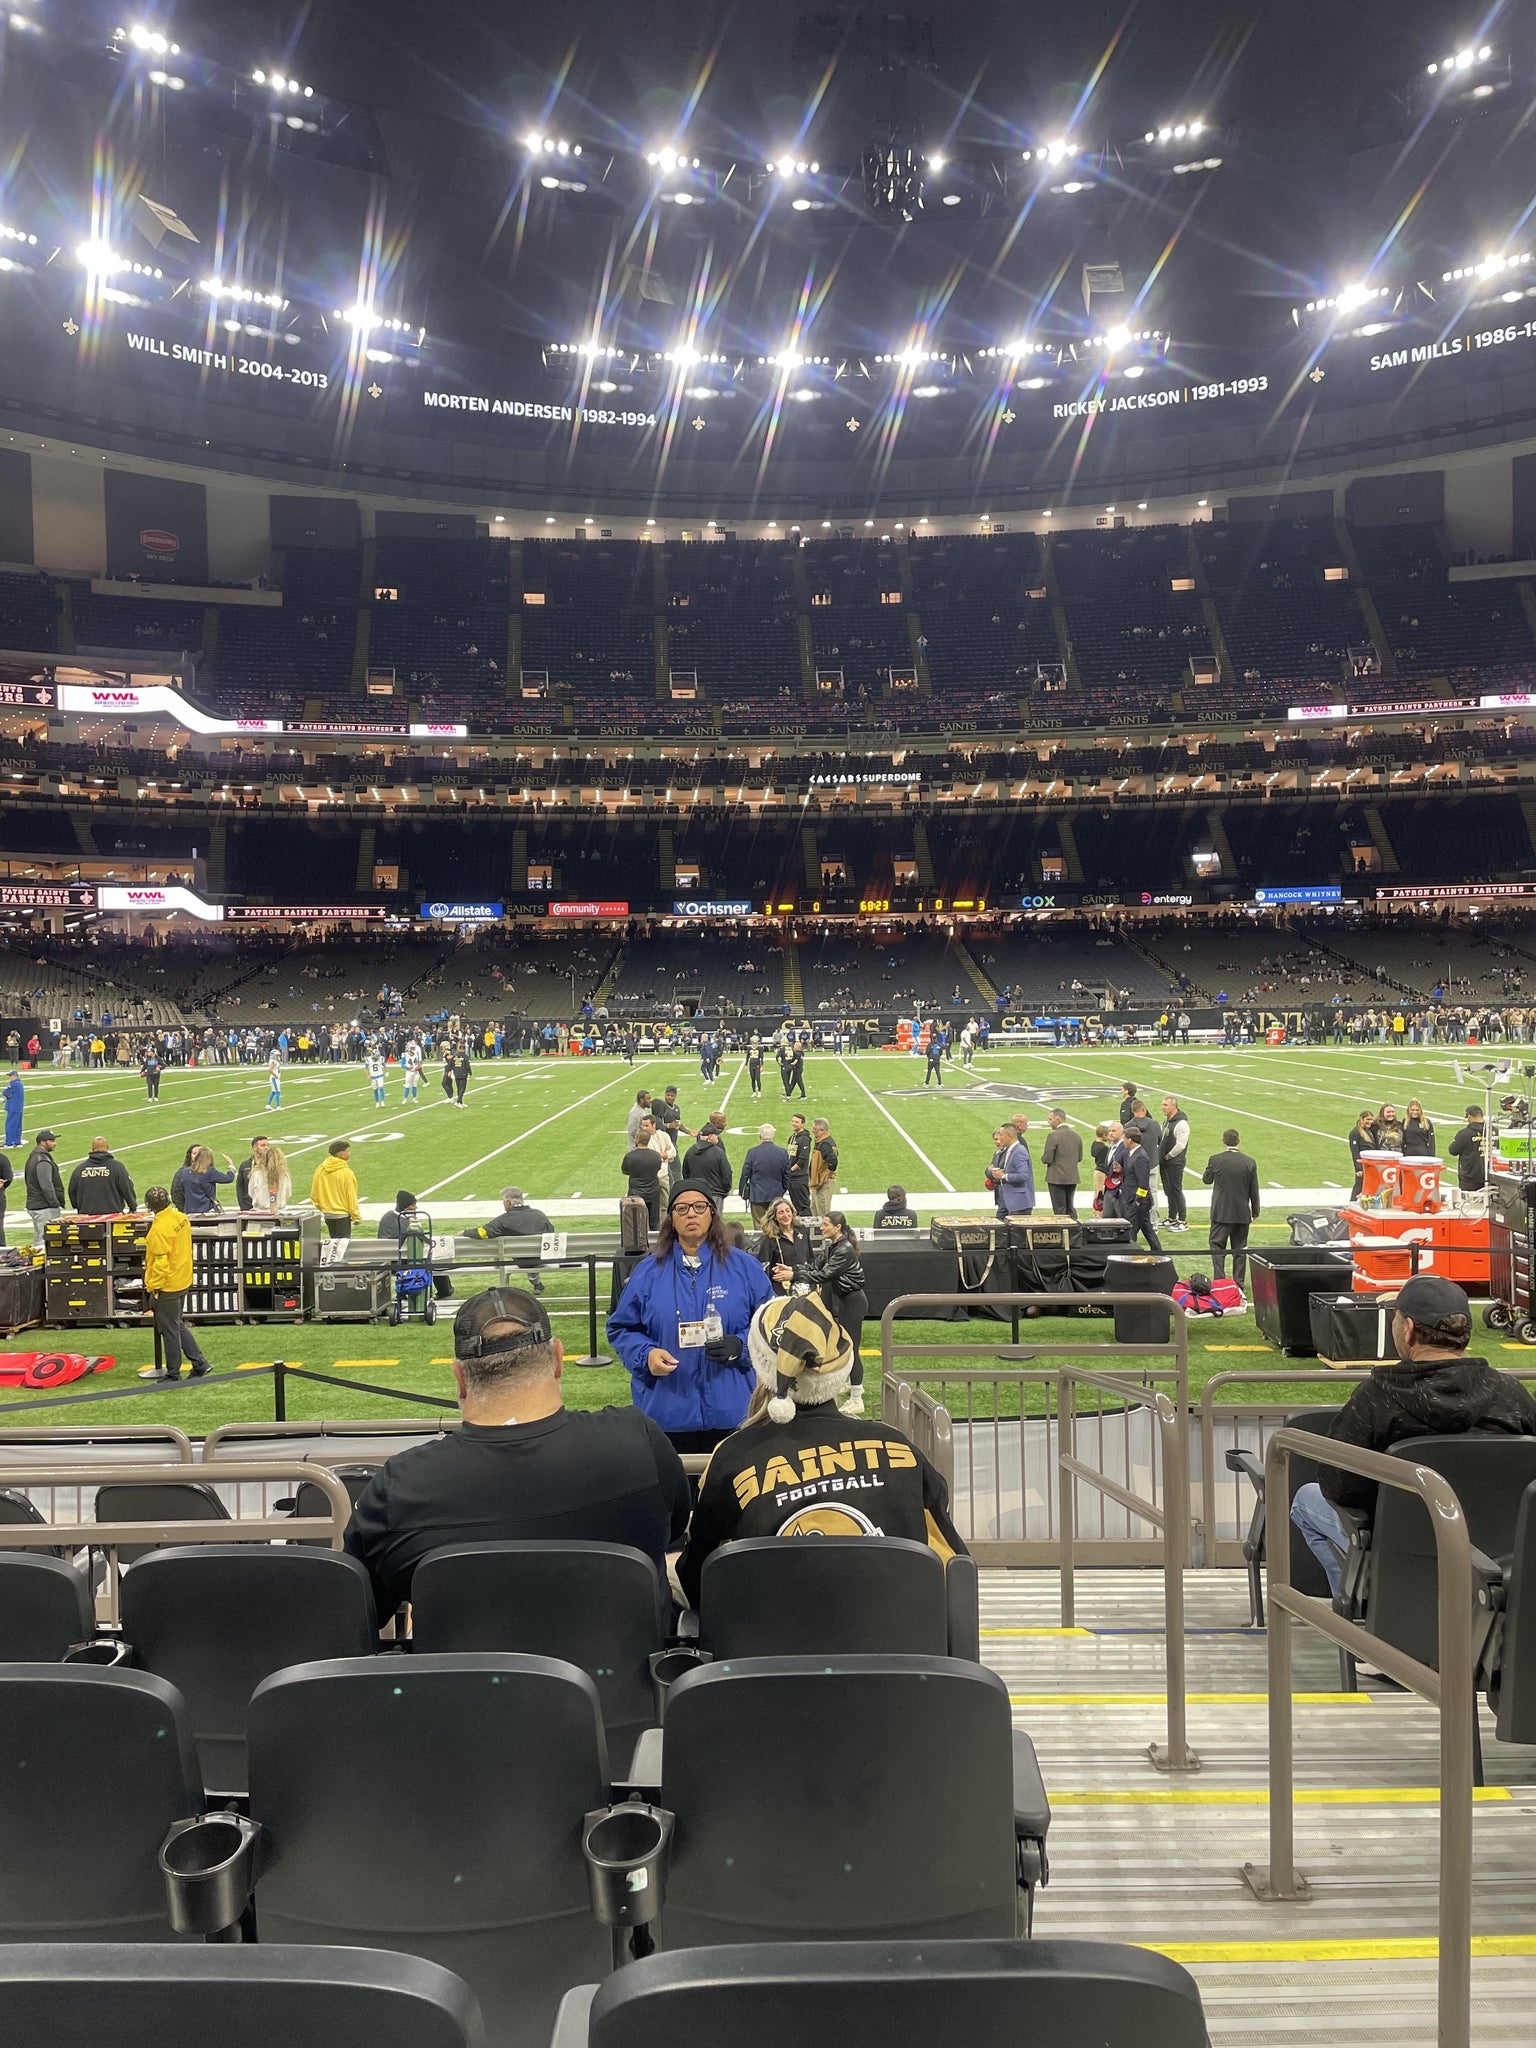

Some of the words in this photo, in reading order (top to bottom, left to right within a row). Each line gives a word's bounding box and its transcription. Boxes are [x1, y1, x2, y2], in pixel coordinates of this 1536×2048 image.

[1370, 350, 1408, 371] SAM
[1411, 338, 1463, 363] MILLS
[127, 332, 169, 357] WILL
[172, 344, 226, 369] SMITH
[238, 358, 328, 389] 2004-2013
[1053, 399, 1106, 418] RICKEY
[1109, 389, 1180, 412] JACKSON
[1191, 376, 1269, 401] 1981-1993
[424, 391, 489, 412] MORTEN
[491, 399, 572, 421] ANDERSEN
[582, 408, 657, 427] 1982-1994
[92, 692, 139, 701] WWL
[1500, 694, 1530, 702] WWL
[1109, 715, 1149, 725] SAINTS
[1198, 712, 1238, 722] SAINTS
[237, 719, 268, 727] WWL
[939, 722, 977, 731] SAINTS
[1024, 719, 1062, 729] SAINTS
[513, 725, 551, 735] SAINTS
[600, 726, 638, 735] SAINTS
[684, 726, 722, 735] SAINTS
[769, 725, 807, 735] SAINTS
[1357, 754, 1395, 764] SAINTS
[1444, 750, 1484, 759] SAINTS
[0, 758, 37, 769] AINTS
[1188, 763, 1225, 772] SAINTS
[1271, 758, 1308, 769] SAINTS
[88, 765, 130, 775] SAINTS
[178, 769, 218, 779] SAINTS
[952, 770, 986, 779] SAINTS
[1030, 769, 1065, 777] SAINTS
[1107, 766, 1143, 775] SAINTS
[266, 773, 304, 782] SAINTS
[349, 774, 386, 783] SAINTS
[432, 775, 468, 784] SAINTS
[511, 776, 547, 785] SAINTS
[590, 776, 625, 785] SAINTS
[666, 776, 701, 785] SAINTS
[744, 775, 778, 784] SAINTS
[809, 774, 862, 784] CAESARS
[862, 772, 922, 782] SUPERDOME
[127, 892, 166, 900] WWL
[1305, 890, 1341, 898] WHITNEY
[1393, 889, 1430, 897] PATRON
[1473, 886, 1524, 894] PARTNERS
[1, 894, 70, 904] PARTNERS
[1021, 896, 1056, 908] COX
[1082, 895, 1120, 904] SAINTS
[1153, 894, 1192, 905] entergy
[507, 905, 544, 914] SAINTS
[553, 903, 600, 915] Community
[686, 902, 749, 915] Ochsner
[765, 904, 773, 915] 3
[813, 902, 820, 912] 0
[859, 900, 889, 911] 68:23
[918, 902, 923, 912] 1
[935, 899, 943, 910] 0
[978, 900, 985, 911] 3
[52, 1021, 59, 1030] 3
[373, 1063, 379, 1072] 6
[81, 1169, 110, 1178] SAINTS
[1382, 1167, 1397, 1184] G
[1420, 1172, 1435, 1190] G
[881, 1218, 913, 1227] SAINTS
[732, 1439, 918, 1510] SAINTS
[775, 1474, 885, 1507] FOOTBALL
